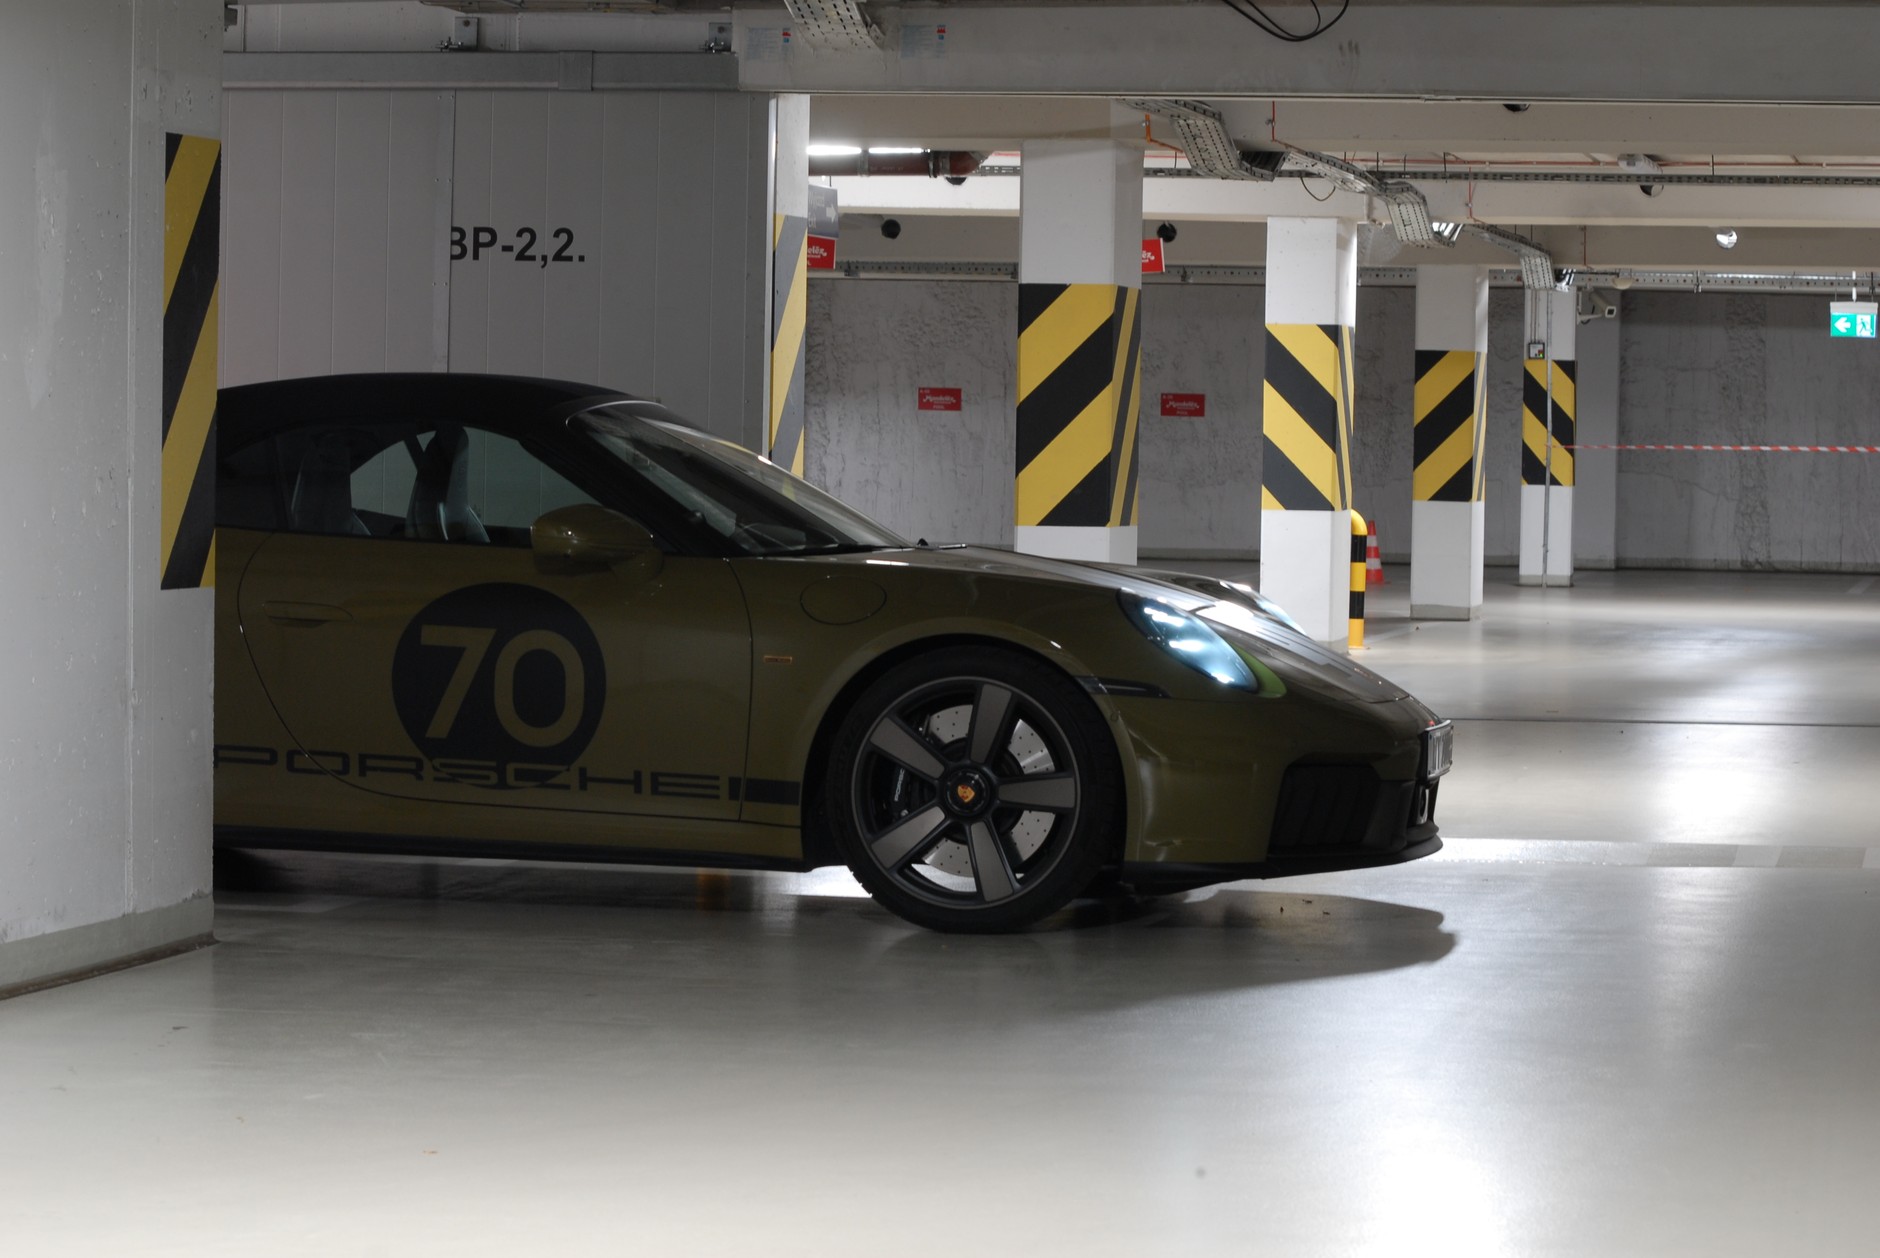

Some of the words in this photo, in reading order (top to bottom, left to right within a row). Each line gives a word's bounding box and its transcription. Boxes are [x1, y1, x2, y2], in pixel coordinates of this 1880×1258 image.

[420, 624, 585, 748] 70
[213, 744, 721, 800] PORSCHE
[894, 768, 905, 802] PORSC
